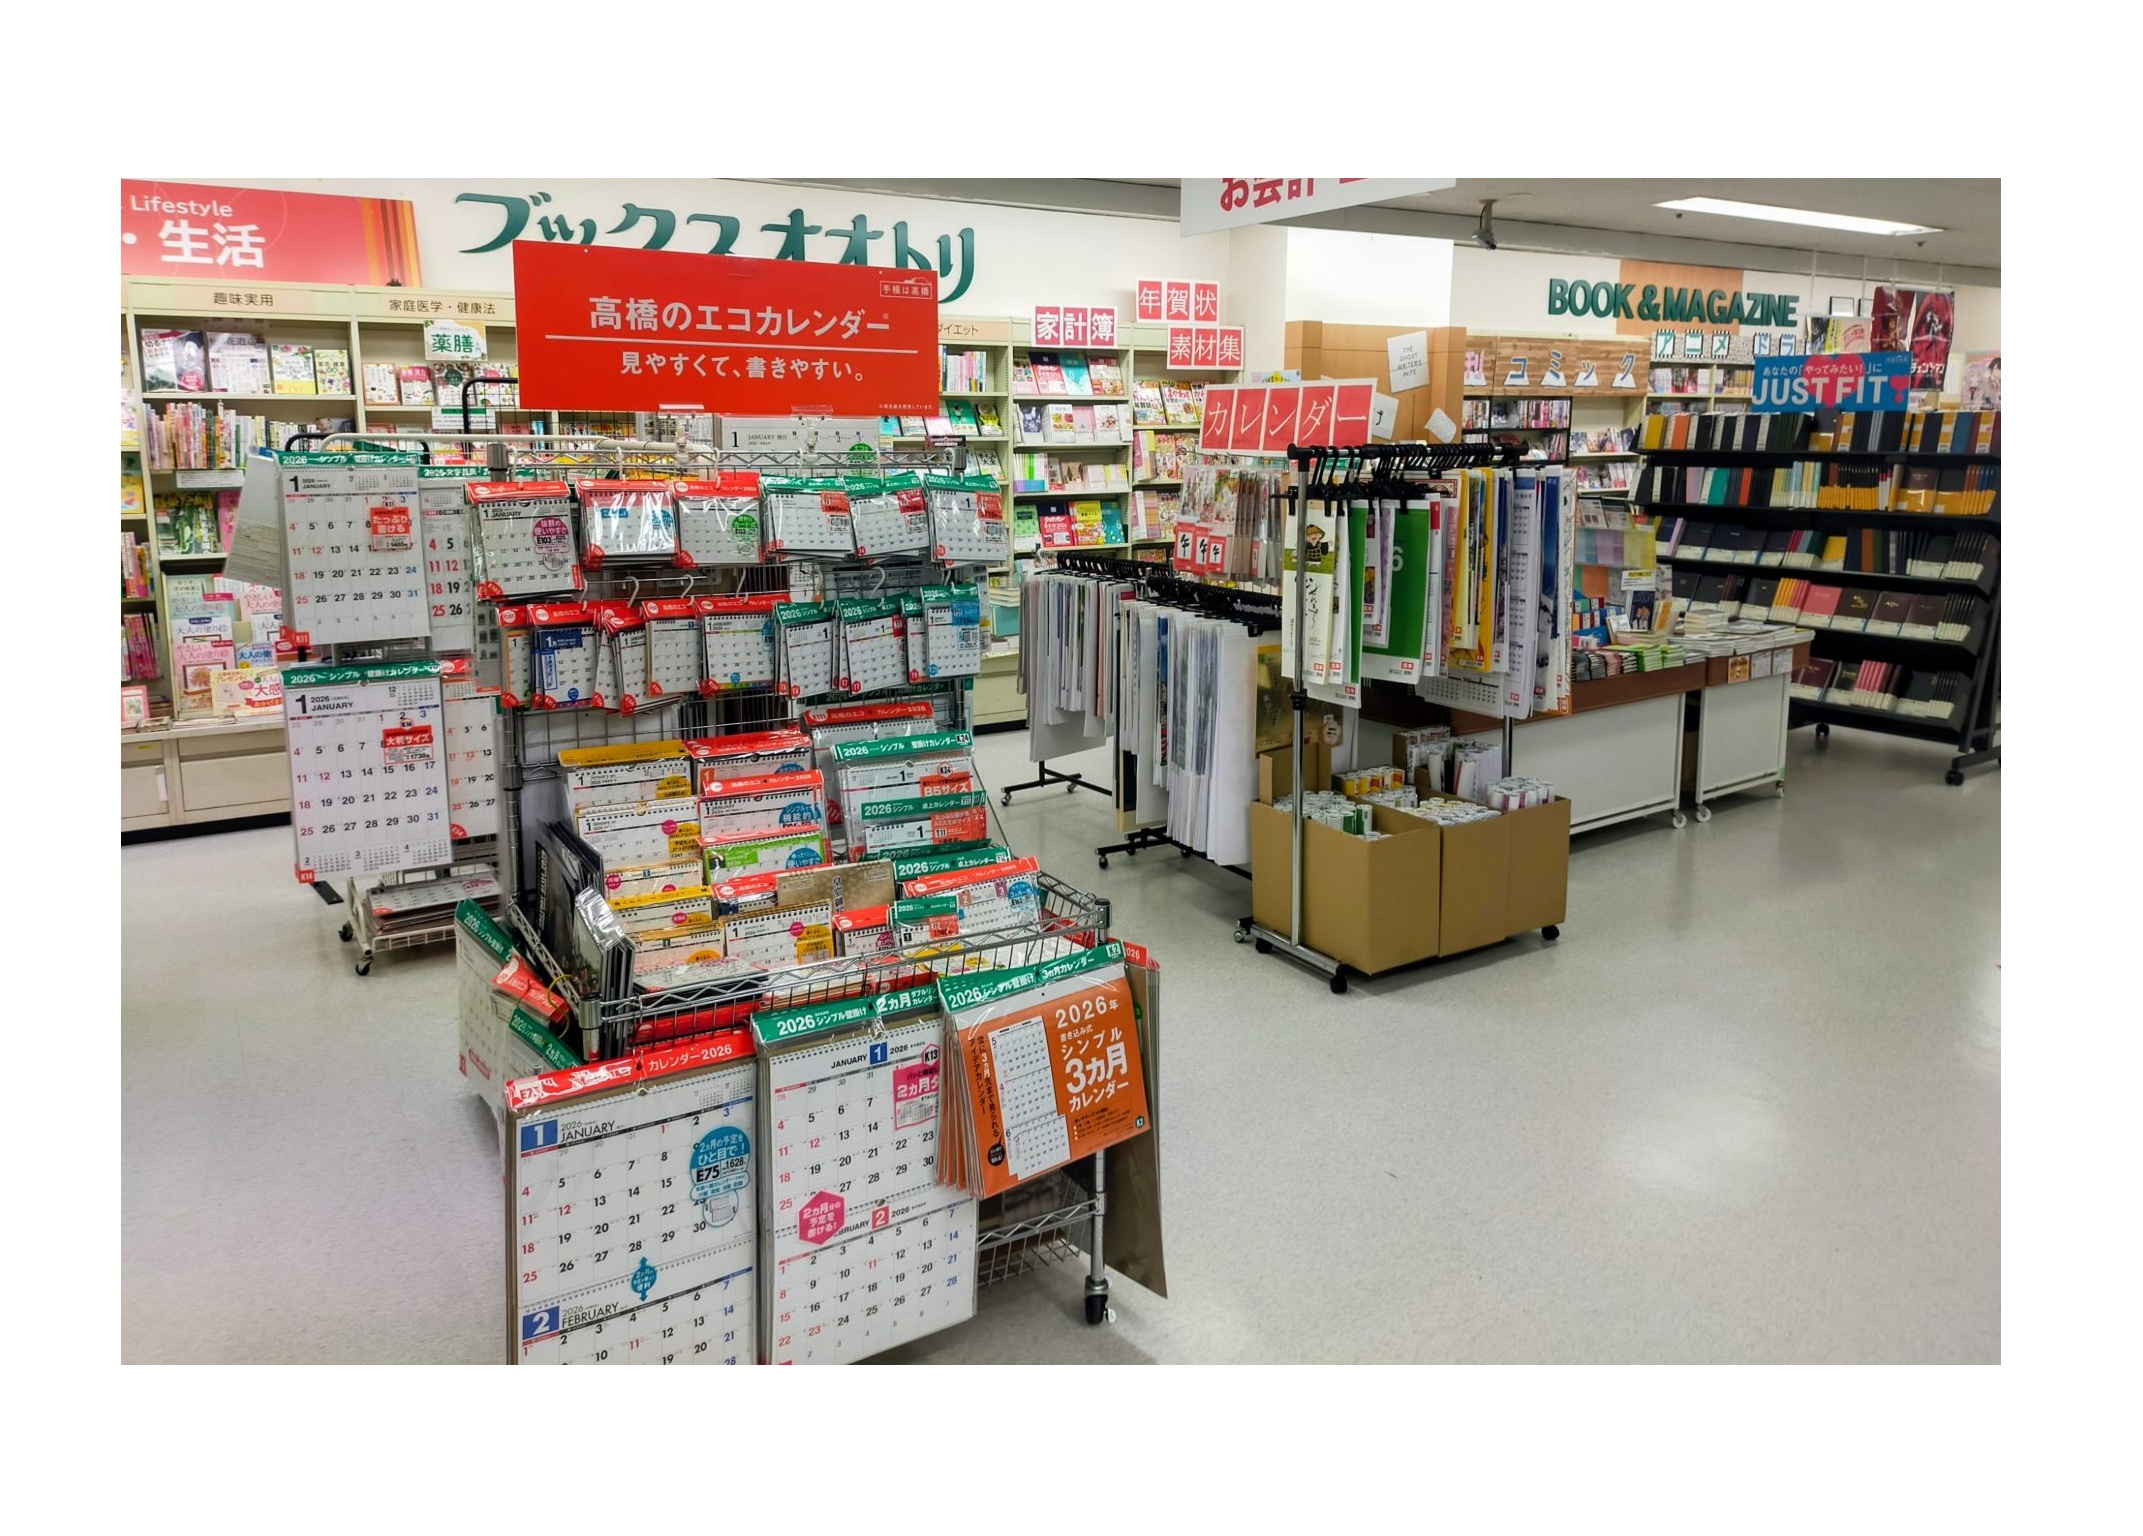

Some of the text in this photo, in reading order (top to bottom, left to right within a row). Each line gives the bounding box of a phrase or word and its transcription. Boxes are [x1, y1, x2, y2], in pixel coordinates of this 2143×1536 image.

[131, 195, 233, 217] Lifestyle
[213, 292, 274, 306] 趣味実用
[389, 298, 496, 315] 家庭医学・健康法
[1138, 289, 1218, 316] 年賀状
[589, 297, 890, 340] 高橋のエコカレンダー
[1035, 312, 1115, 342] 家計簿
[431, 333, 474, 353] 薬膳
[1170, 333, 1241, 362] 素材集
[1657, 332, 1727, 357] アニメ
[621, 351, 864, 383] 見やすくて、書きやすい。
[1510, 350, 1636, 380] コミック
[1752, 376, 1888, 405] JUST FIT
[1205, 397, 1367, 441] カレンダー
[283, 456, 307, 464] 2026
[289, 476, 299, 492] 1
[373, 516, 407, 524] たっぷり
[429, 561, 441, 571] 11
[432, 605, 445, 616] 25
[781, 609, 801, 619] 2026
[843, 606, 862, 617] 2026
[822, 627, 828, 639] 1
[291, 671, 360, 683] 2026 シンプル
[296, 695, 307, 714] 1
[311, 702, 353, 711] JANUARY
[844, 747, 869, 756] 2026
[880, 743, 904, 752] シンプル
[899, 771, 906, 781] 1
[924, 784, 968, 797] B5サイズ
[865, 805, 892, 816] 2026
[301, 812, 439, 836] 25 26 27 28 29 30 31
[917, 826, 924, 838] 1
[899, 862, 929, 875] 2026
[732, 928, 738, 937] 1
[1127, 948, 1140, 960] 026
[949, 988, 982, 1009] 2026
[1056, 996, 1118, 1029] 2026年
[777, 1015, 816, 1035] 2026
[1060, 1024, 1094, 1042] 書き込み式
[1061, 1027, 1122, 1061] シンプル
[649, 1044, 732, 1073] カレンダー 2026
[831, 1044, 908, 1069] JANUARY 1 2026
[924, 1050, 938, 1062] K13
[969, 1038, 985, 1115] アイデアカレンダー
[1069, 1081, 1129, 1114] カレンダー
[533, 1126, 544, 1146] 1
[560, 1121, 615, 1143] JANUARY
[561, 1123, 582, 1131] 2026
[868, 1131, 934, 1158] 21 22 23
[558, 1152, 668, 1188] 5 6 7 8
[696, 1165, 720, 1182] E75
[522, 1178, 672, 1225] 11 12 13 14 15
[875, 1207, 910, 1226] 2 2026
[523, 1221, 706, 1282] 25 26 27 28 29 30
[809, 1263, 933, 1312] 16 17 18 19 20
[562, 1306, 583, 1316] 2026
[562, 1302, 619, 1328] FEBRUARY
[533, 1312, 549, 1335] 2
